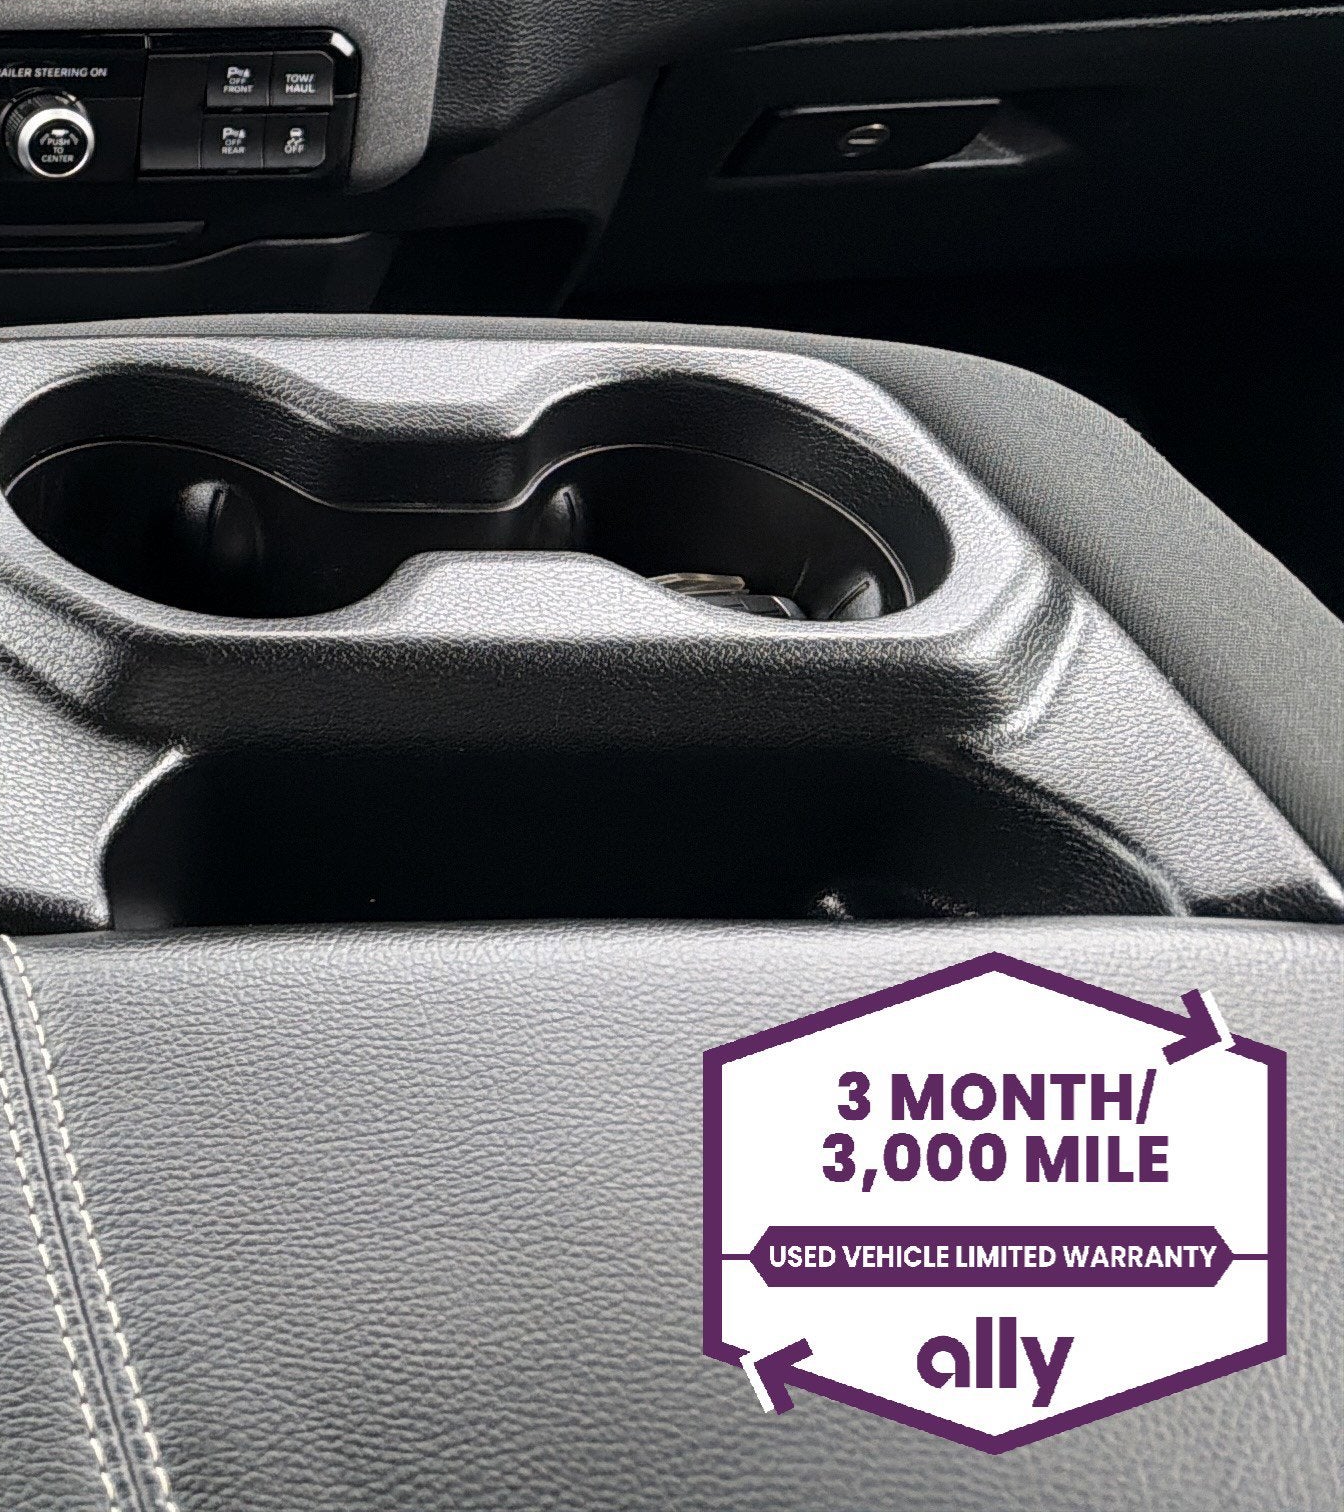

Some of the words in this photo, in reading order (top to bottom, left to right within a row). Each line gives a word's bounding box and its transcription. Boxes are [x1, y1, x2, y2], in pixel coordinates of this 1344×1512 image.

[34, 67, 89, 78] STEERING
[90, 67, 109, 78] ON
[285, 73, 315, 83] TOW/
[223, 85, 254, 94] FRONT
[285, 83, 316, 94] HAUL
[47, 138, 71, 146] PUSH
[53, 146, 64, 155] TO
[284, 144, 305, 155] OFF
[41, 154, 74, 163] CENTER
